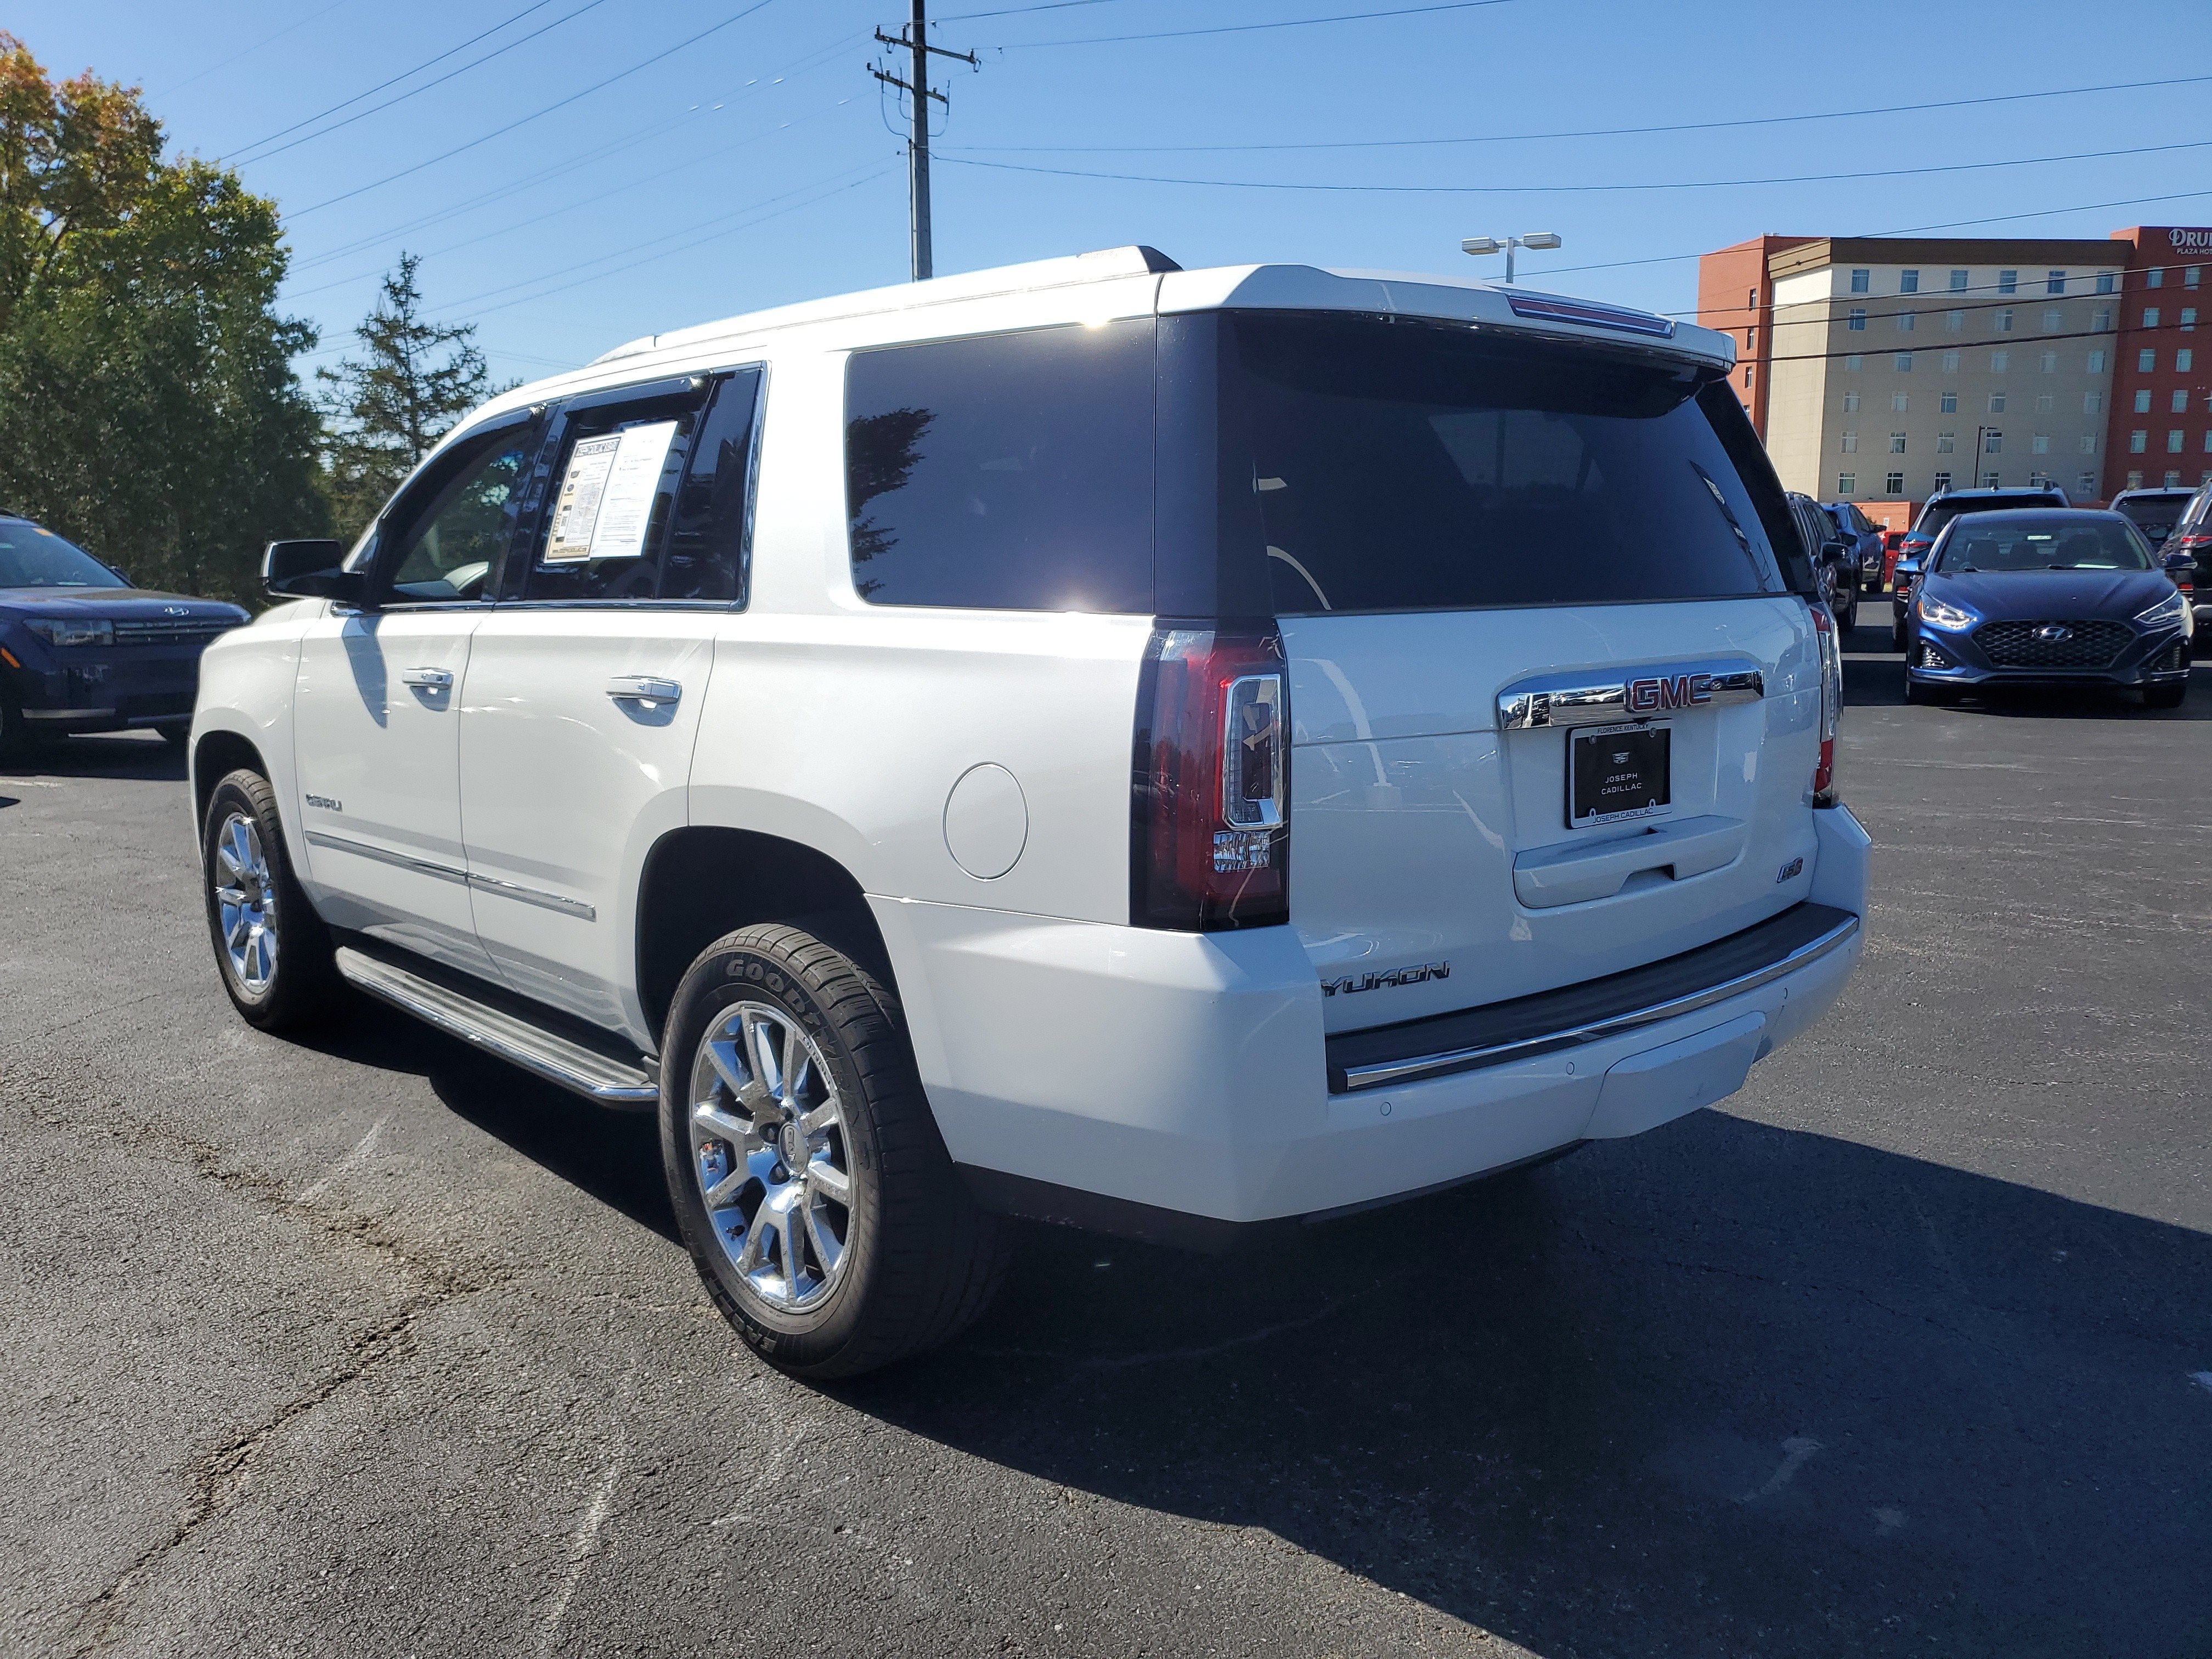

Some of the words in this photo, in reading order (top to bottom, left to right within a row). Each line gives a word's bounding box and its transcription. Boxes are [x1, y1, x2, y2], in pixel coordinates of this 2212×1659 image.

[1632, 673, 1711, 711] GMC
[1605, 772, 1638, 783] JOSEPH
[1601, 782, 1643, 795] CADILLAC
[1593, 812, 1619, 823] JOSEPH
[1621, 808, 1654, 819] CADILLAC
[1321, 960, 1450, 997] YUKON
